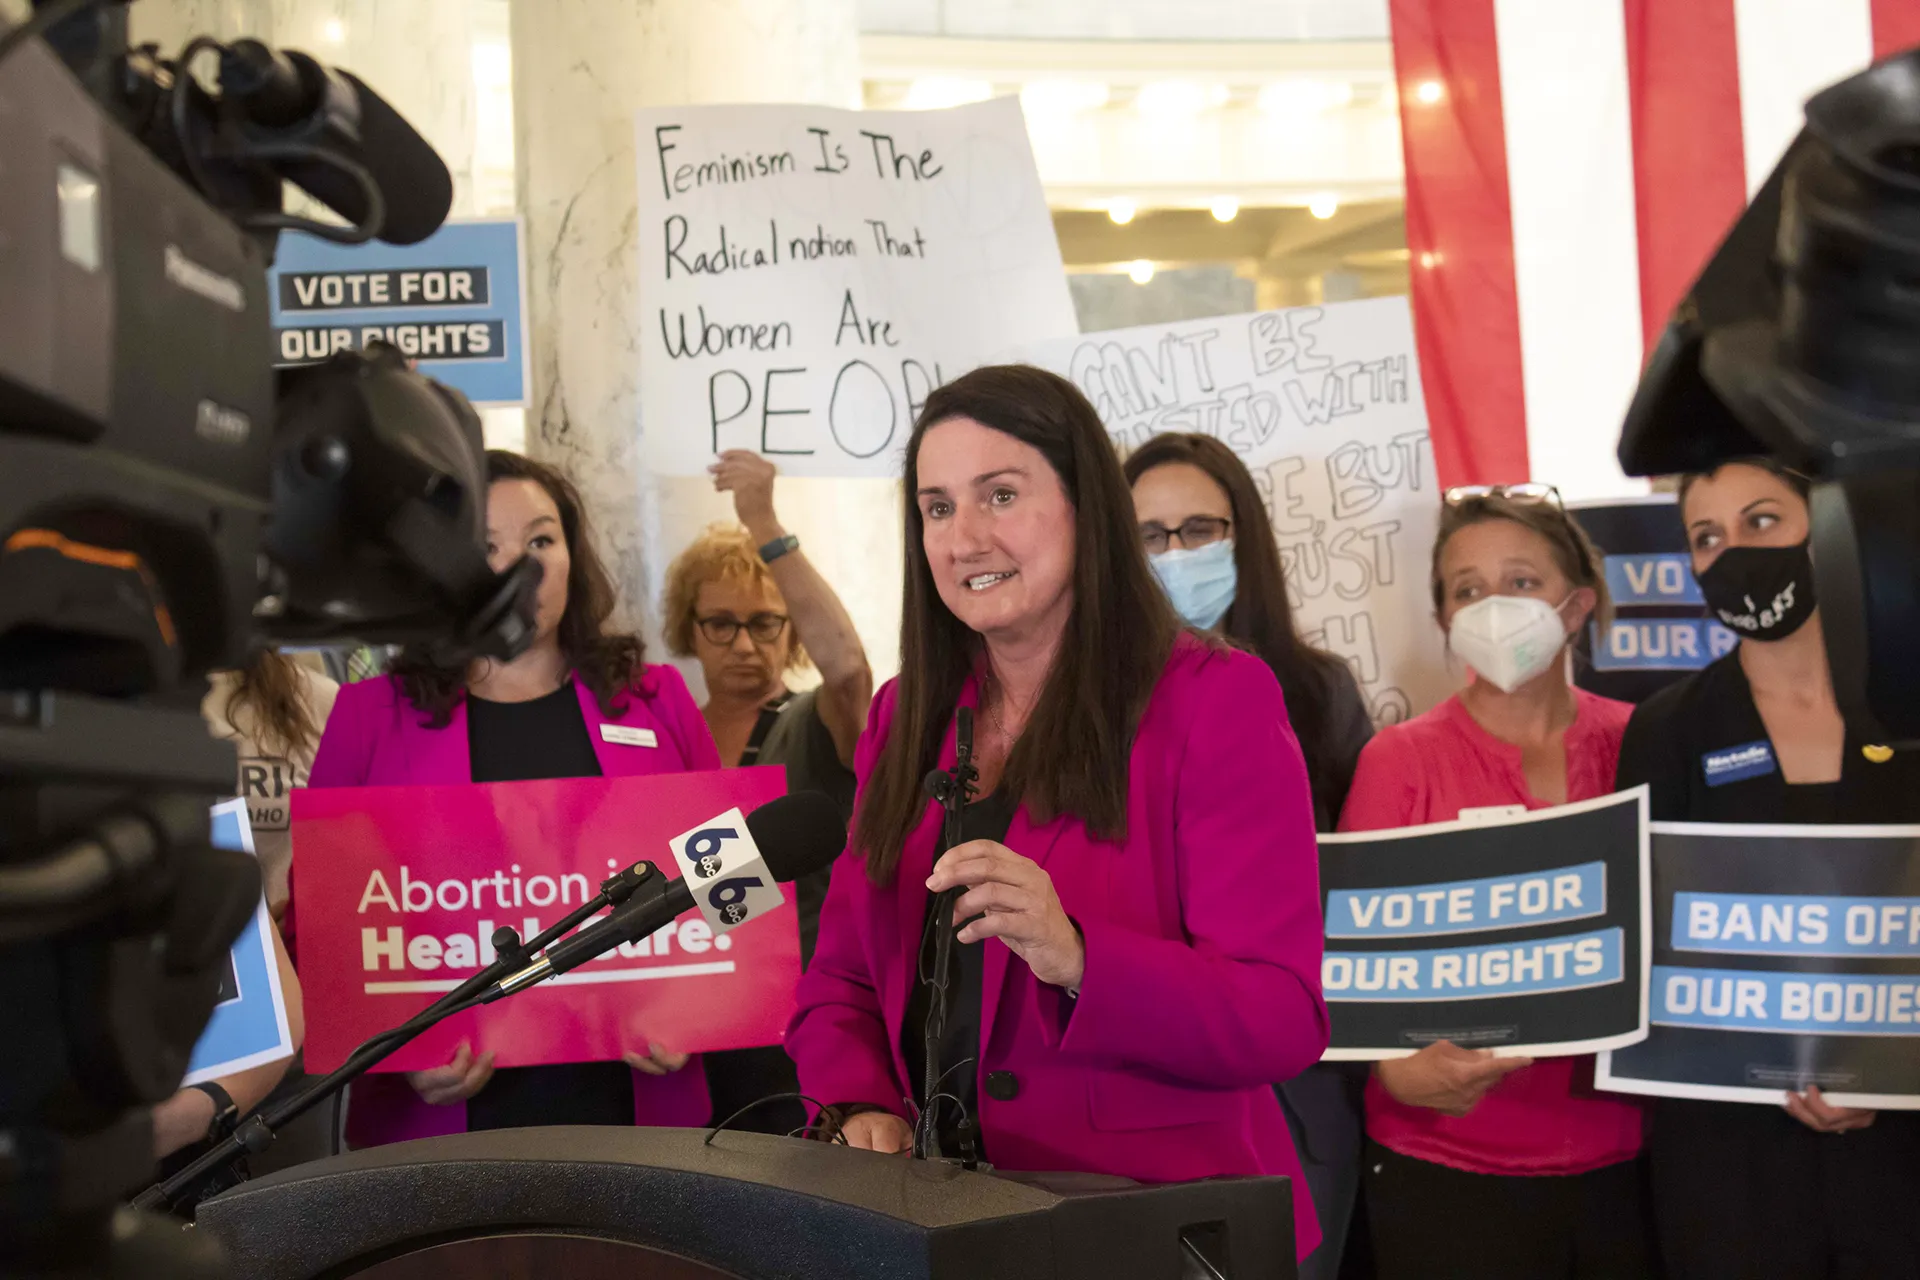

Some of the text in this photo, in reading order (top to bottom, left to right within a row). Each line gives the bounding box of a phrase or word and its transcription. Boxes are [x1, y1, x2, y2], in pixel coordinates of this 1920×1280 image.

[655, 125, 944, 200] Feminism Is The
[664, 214, 778, 279] Radical
[864, 219, 927, 259] That
[293, 270, 474, 306] VOTE FOR
[281, 328, 353, 360] OUR
[660, 289, 900, 359] Women Are
[1249, 307, 1333, 376] BE
[708, 357, 944, 459] PEOP
[1283, 354, 1409, 427] WITH
[1325, 430, 1430, 521] BUT
[1611, 625, 1699, 659] OUR
[685, 828, 739, 863] 6
[700, 856, 716, 877] abc
[357, 863, 590, 914] Abortion
[708, 876, 764, 911] 6
[725, 903, 742, 923] abc
[1348, 873, 1584, 929] VOTE FOR
[1687, 901, 1829, 945] BANS
[1322, 937, 1605, 991] OUR RIGHTS
[1664, 976, 1920, 1024] OUR BODIE
